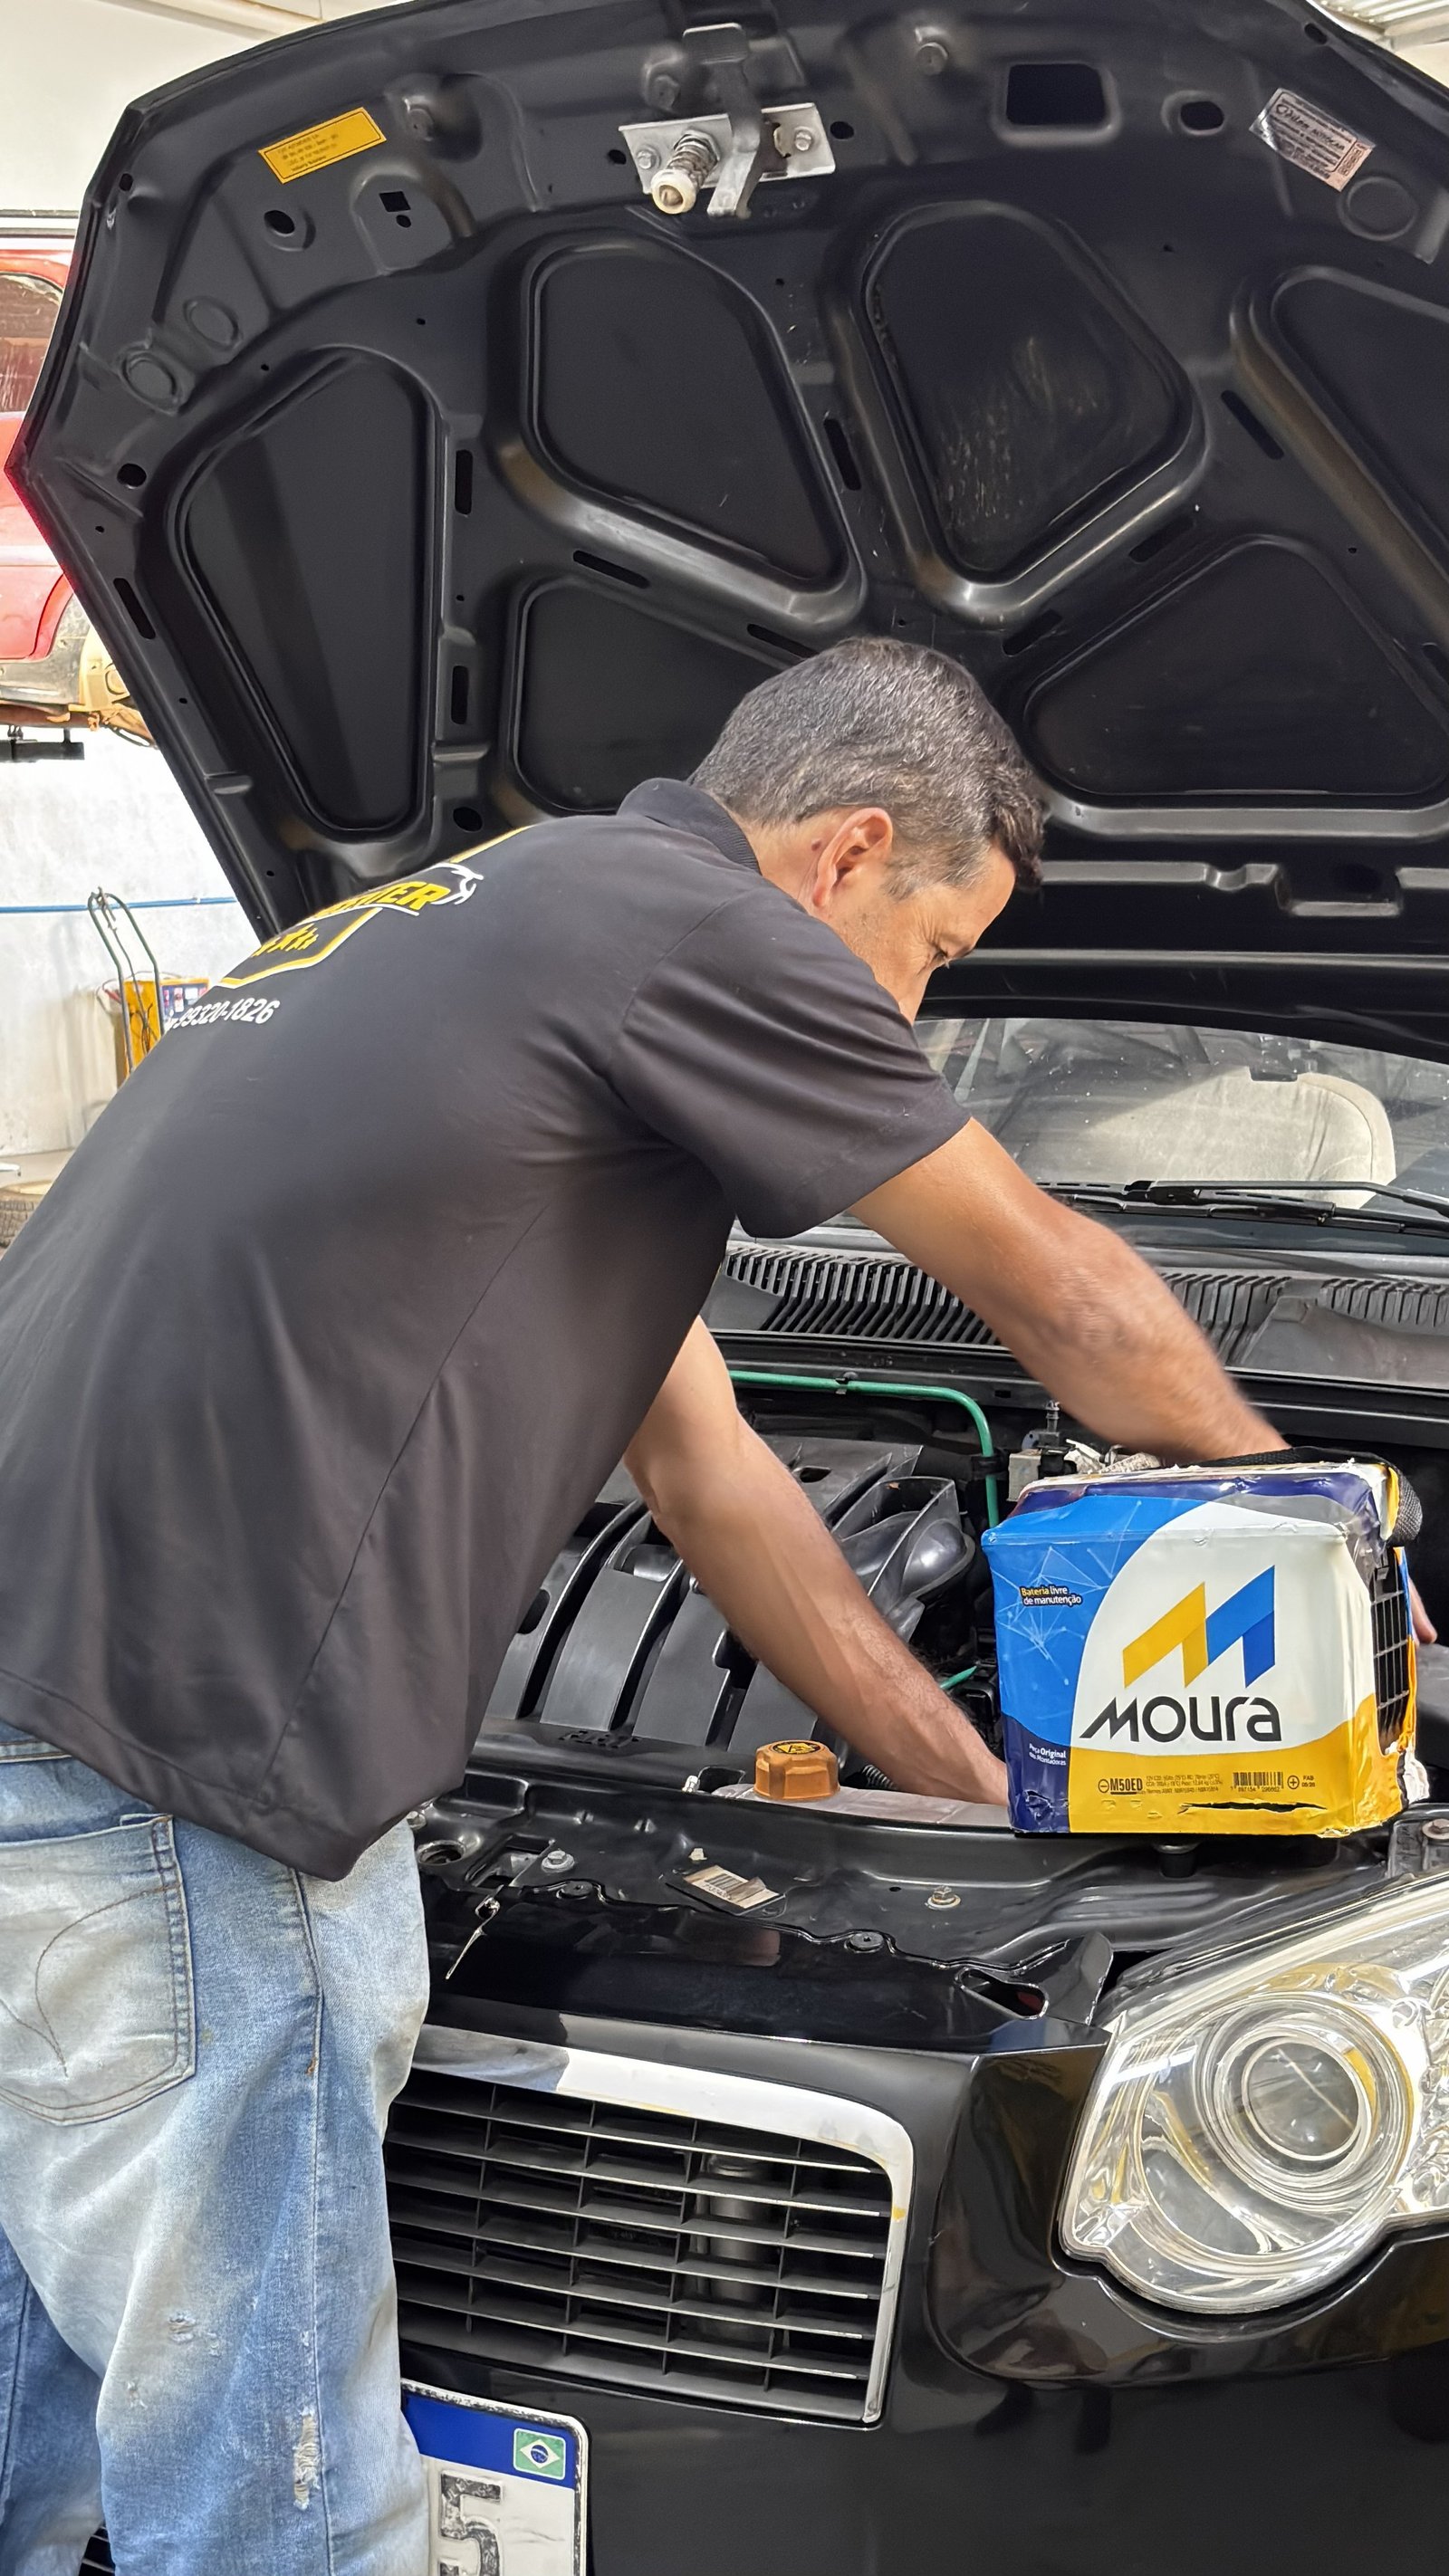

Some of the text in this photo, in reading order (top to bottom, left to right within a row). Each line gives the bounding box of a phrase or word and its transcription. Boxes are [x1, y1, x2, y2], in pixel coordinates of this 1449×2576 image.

[1021, 1585, 1068, 1596] Bateria livre
[1023, 1594, 1081, 1606] de manutenção
[1041, 1748, 1066, 1758] Original
[440, 2472, 502, 2576] 5
